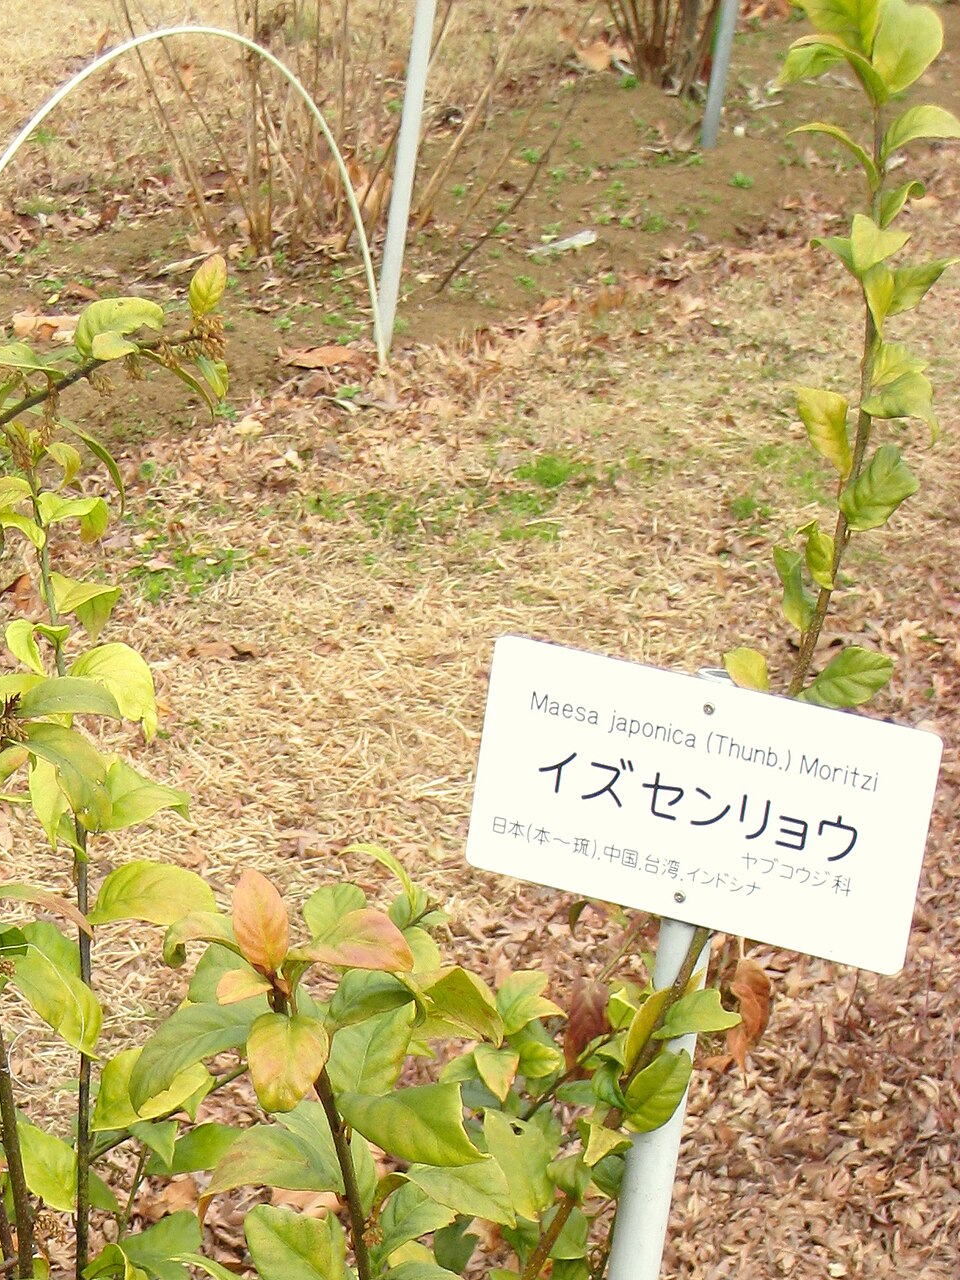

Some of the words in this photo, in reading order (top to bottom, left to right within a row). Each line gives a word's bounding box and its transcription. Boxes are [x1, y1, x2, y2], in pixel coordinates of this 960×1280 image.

[530, 690, 600, 726] Maesa
[607, 710, 697, 749] japonica
[706, 732, 792, 772] (Thunb.)
[799, 755, 880, 793] Moritzi
[537, 751, 860, 863] イズセンリョウ
[741, 852, 853, 897] ヤブコウジ科
